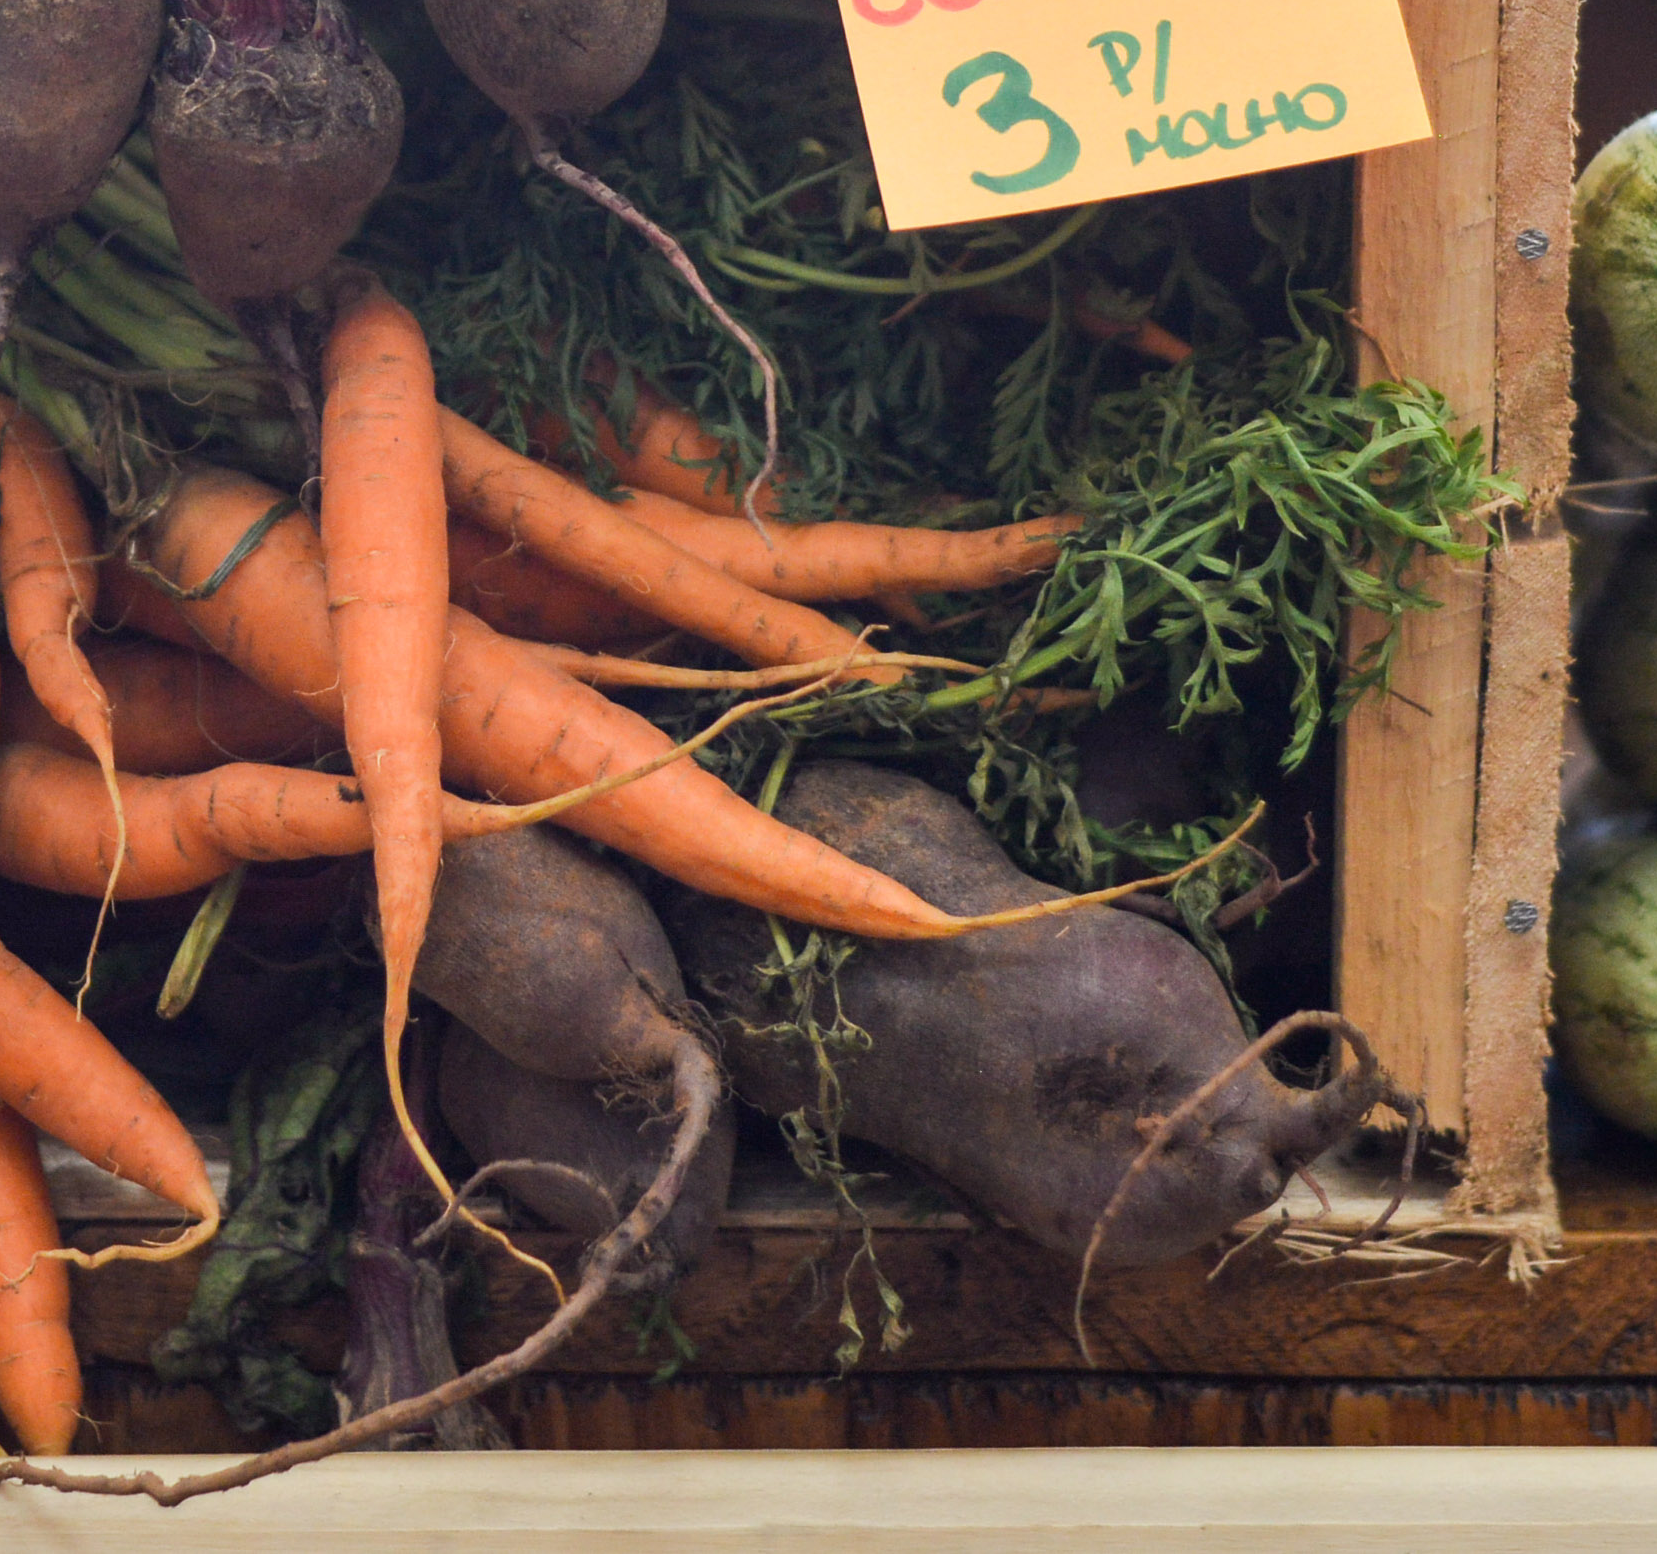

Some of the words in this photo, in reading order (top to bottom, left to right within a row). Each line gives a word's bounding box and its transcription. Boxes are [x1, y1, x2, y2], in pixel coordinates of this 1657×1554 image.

[942, 51, 1081, 195] 3
[1088, 19, 1172, 104] P/
[1125, 82, 1348, 166] MOLHO
